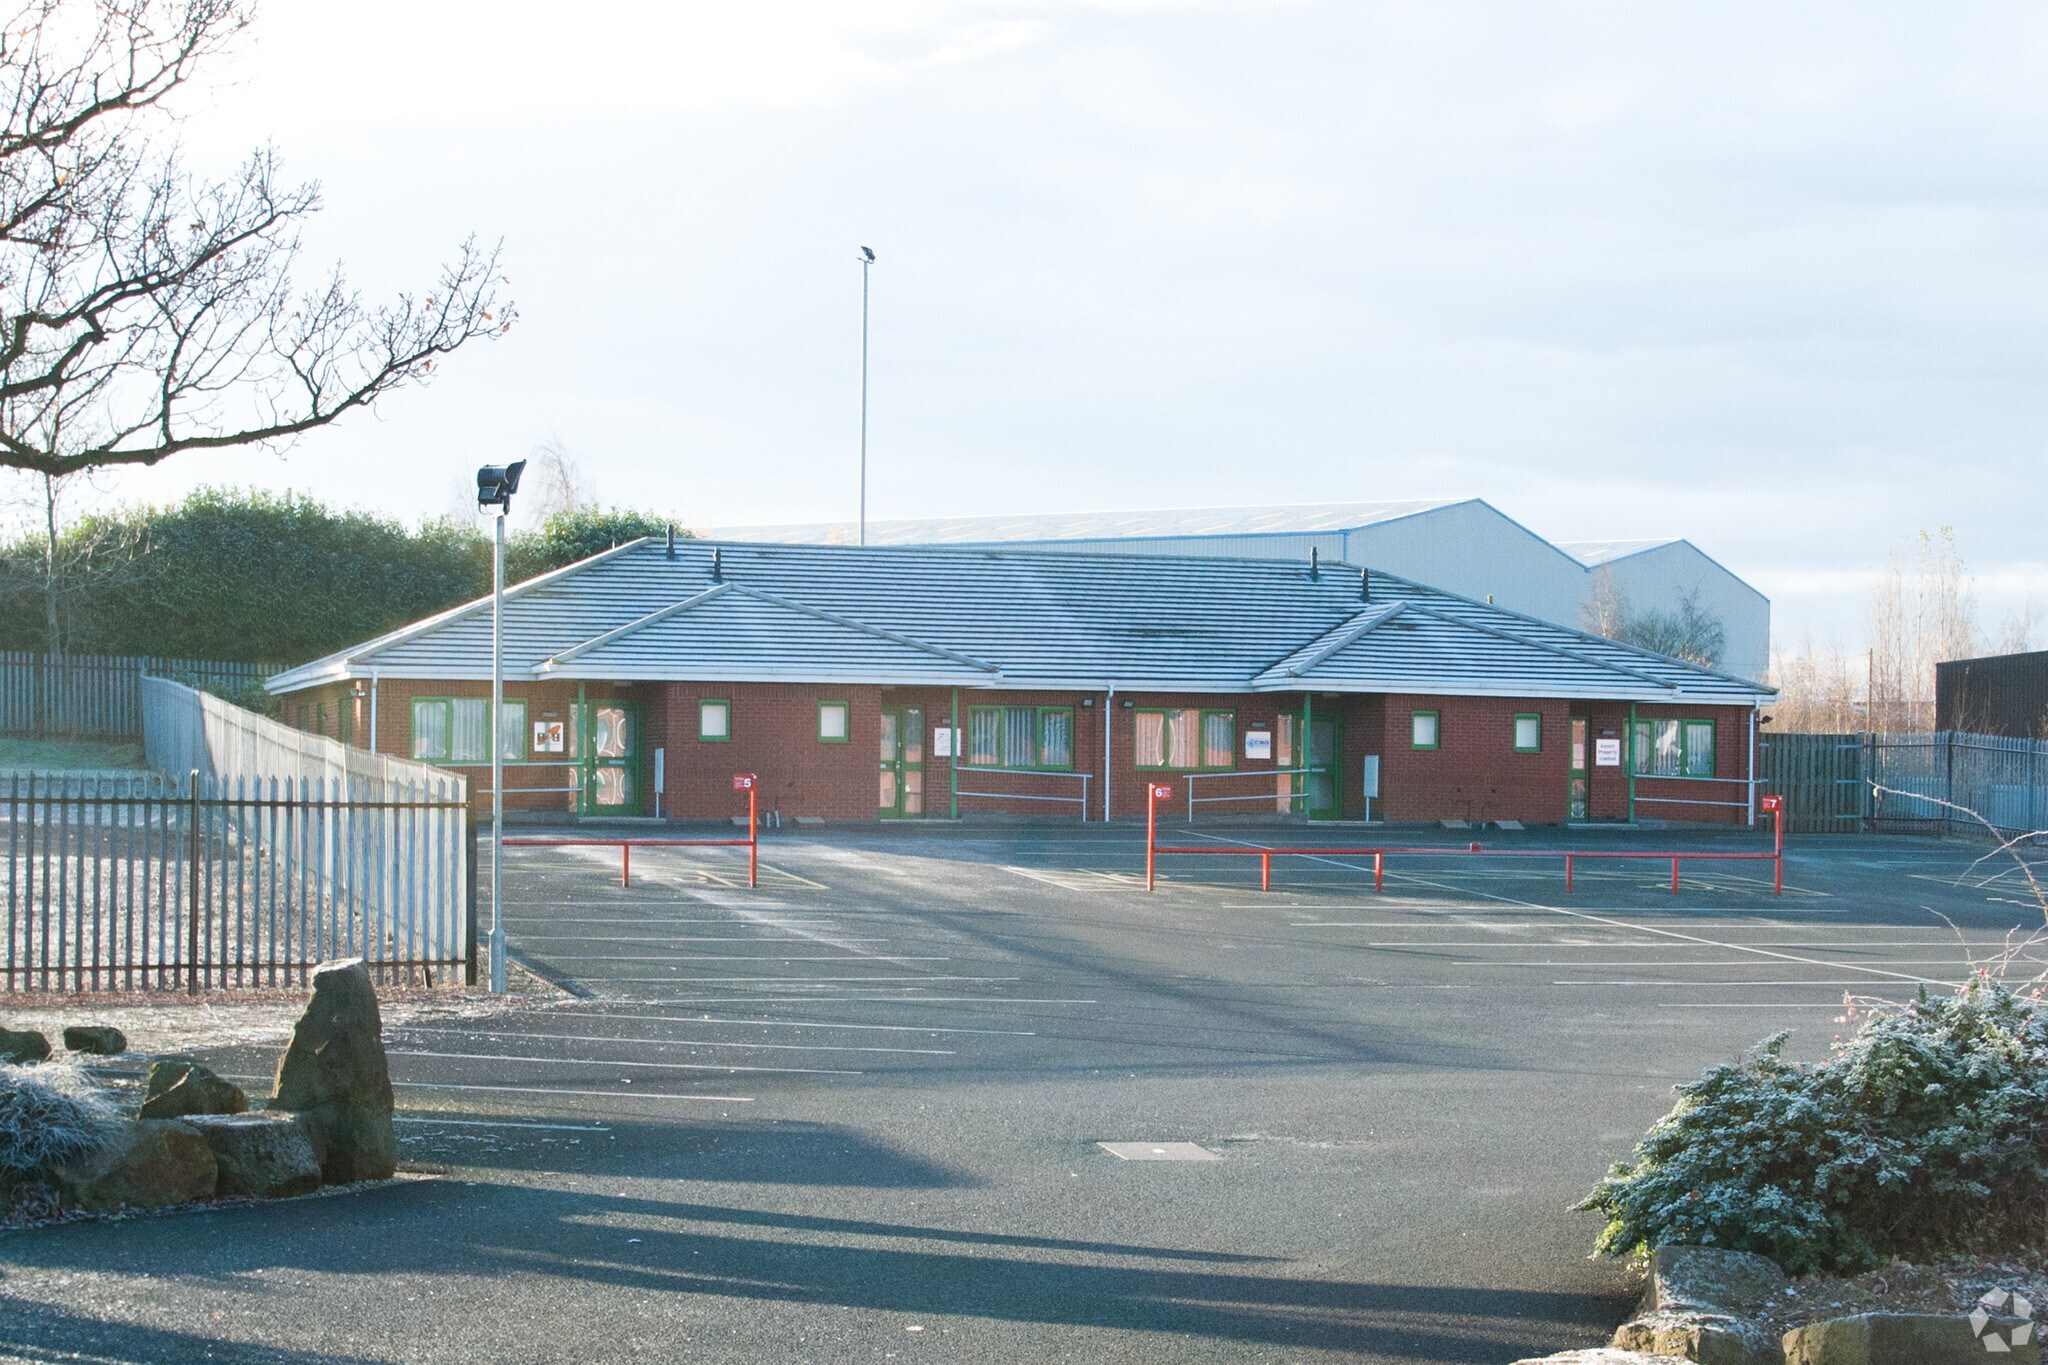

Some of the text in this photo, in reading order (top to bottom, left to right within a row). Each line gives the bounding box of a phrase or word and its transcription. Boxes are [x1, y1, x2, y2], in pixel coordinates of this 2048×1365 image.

[744, 778, 751, 788] 5
[1155, 788, 1163, 798] 6
[1770, 799, 1777, 808] 7
